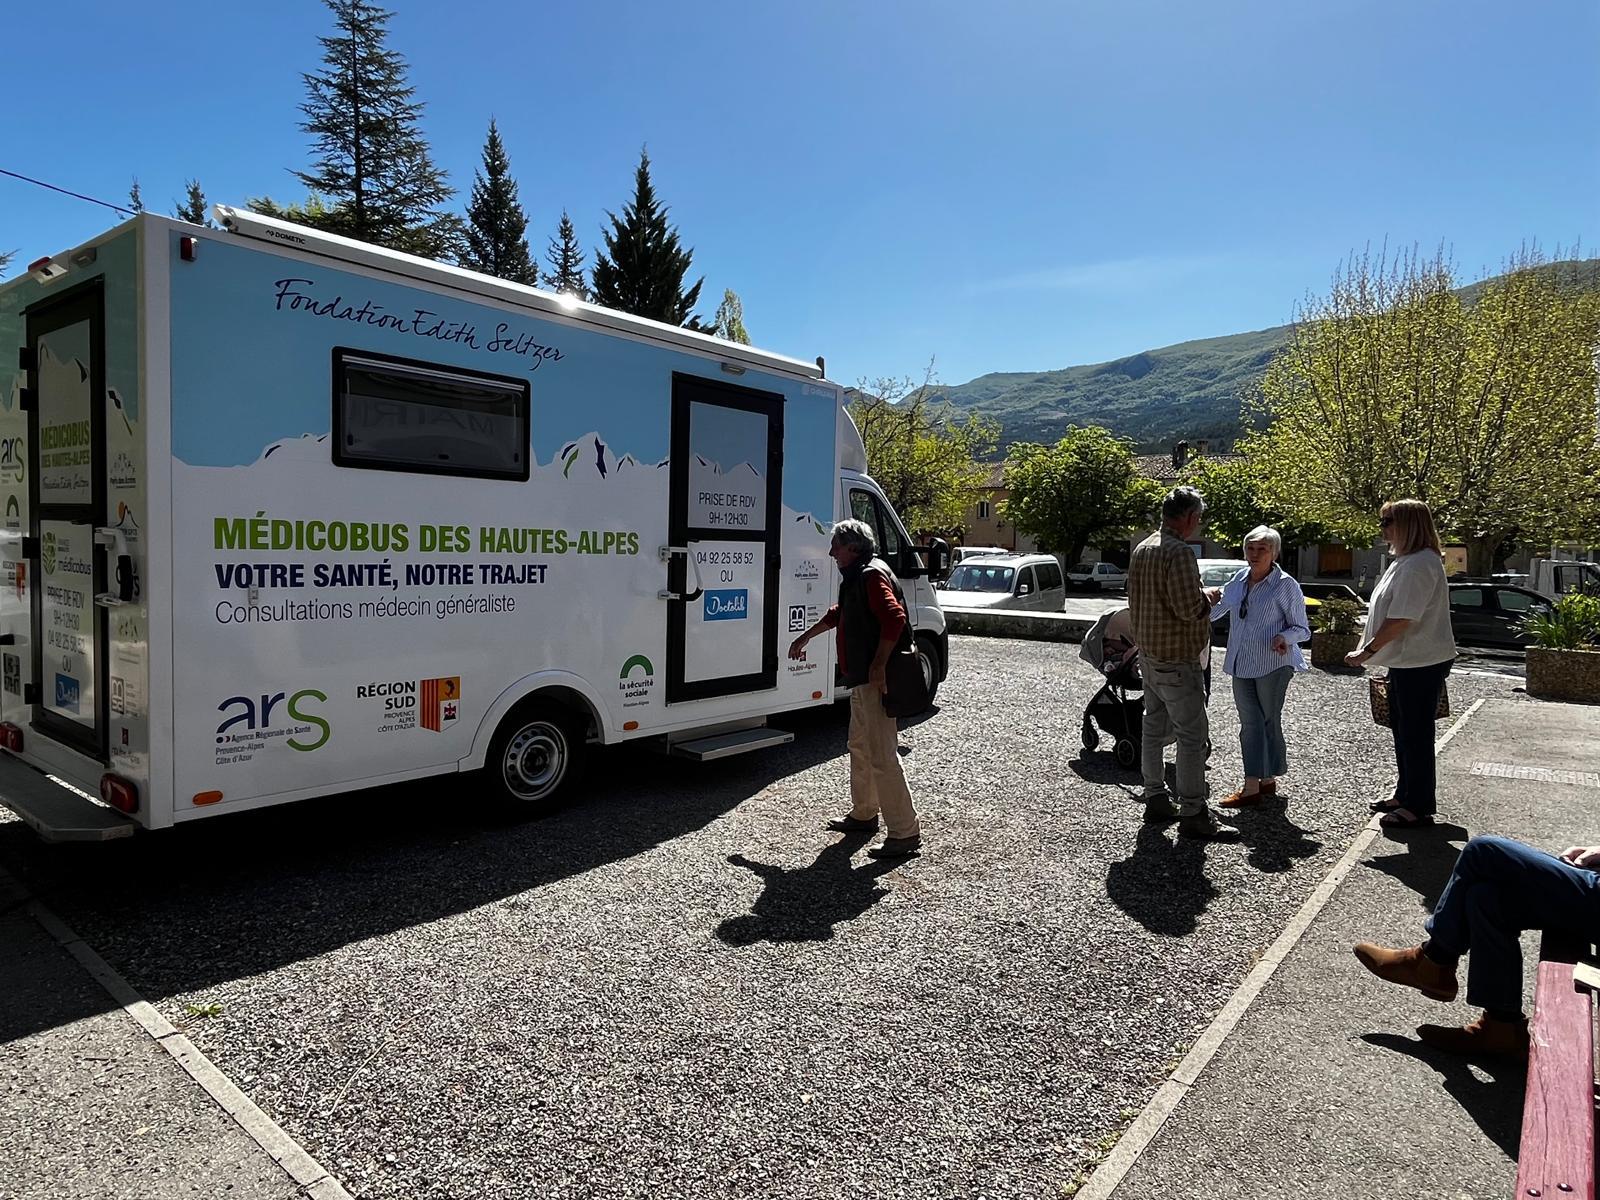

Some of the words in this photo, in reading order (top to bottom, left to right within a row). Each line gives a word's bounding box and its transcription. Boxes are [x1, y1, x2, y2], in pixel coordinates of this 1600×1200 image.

[275, 231, 306, 245] DOMETIC
[274, 278, 410, 333] Fondation
[411, 310, 481, 350] Edith
[487, 323, 565, 371] Seltzer
[41, 419, 90, 450] MÉDICOBUS
[698, 492, 725, 506] PRISE
[726, 494, 738, 507] DE
[739, 495, 756, 508] RDV
[709, 511, 748, 526] 9H-12H30
[214, 511, 409, 552] MÉDICOBUS
[419, 525, 471, 553] DES
[479, 527, 639, 555] HAUTES-ALPES
[697, 551, 707, 564] 04
[709, 551, 719, 564] 92
[721, 552, 731, 564] 25
[732, 552, 743, 564] 58
[744, 552, 754, 564] 52
[214, 563, 305, 588] VOTRE
[313, 558, 398, 591] SANTÉ,
[406, 563, 474, 586] NOTRE
[479, 564, 548, 584] TRAJET
[720, 569, 733, 582] OU
[215, 598, 353, 624] Consultations
[359, 595, 431, 618] médecin
[436, 593, 516, 619] généraliste
[706, 596, 745, 616] Doctolib
[62, 655, 72, 673] OU
[357, 681, 416, 698] RÉGION
[619, 682, 626, 690] la
[625, 688, 648, 698] sociale
[385, 696, 416, 710] SUD
[216, 689, 331, 752] ars
[384, 710, 415, 719] PROVENCE
[398, 716, 416, 724] ALPES
[231, 733, 254, 743] Agence
[285, 727, 294, 735] de
[294, 725, 312, 734] Santé
[377, 724, 393, 733] CÔTE
[215, 742, 265, 756] Provence-Alpes
[215, 755, 231, 765] Côte
[232, 754, 253, 763] d'Azur
